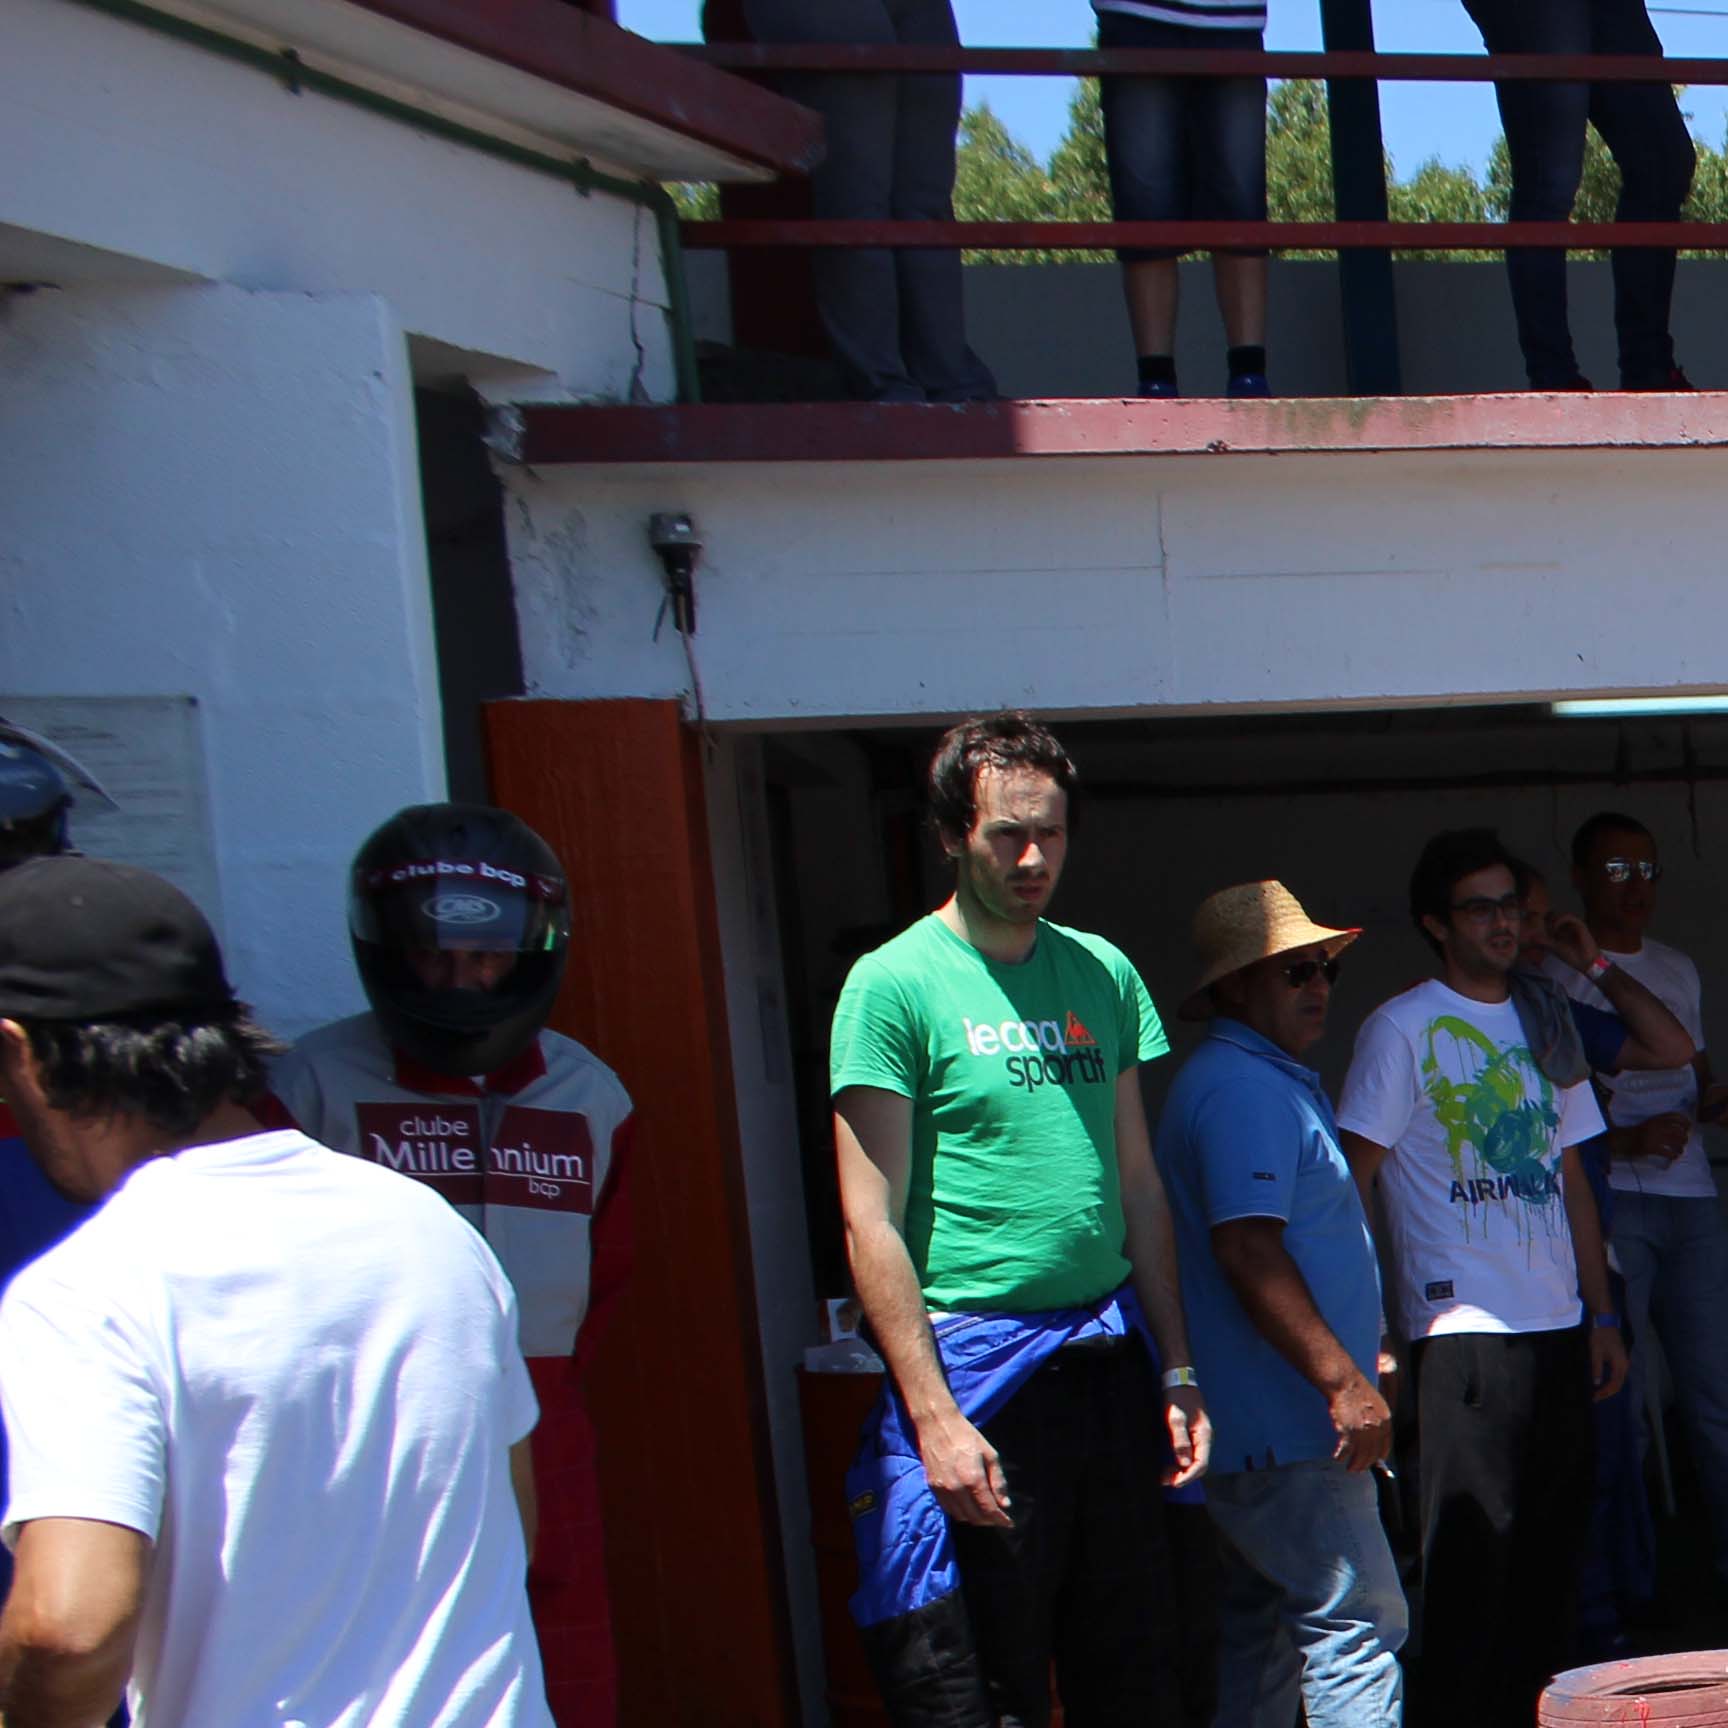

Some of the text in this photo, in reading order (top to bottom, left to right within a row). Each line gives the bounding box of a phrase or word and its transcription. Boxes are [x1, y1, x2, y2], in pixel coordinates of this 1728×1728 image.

[391, 862, 528, 888] clube bcp
[1005, 1048, 1107, 1093] sportif
[400, 1115, 470, 1137] clube
[528, 1177, 561, 1199] bcp
